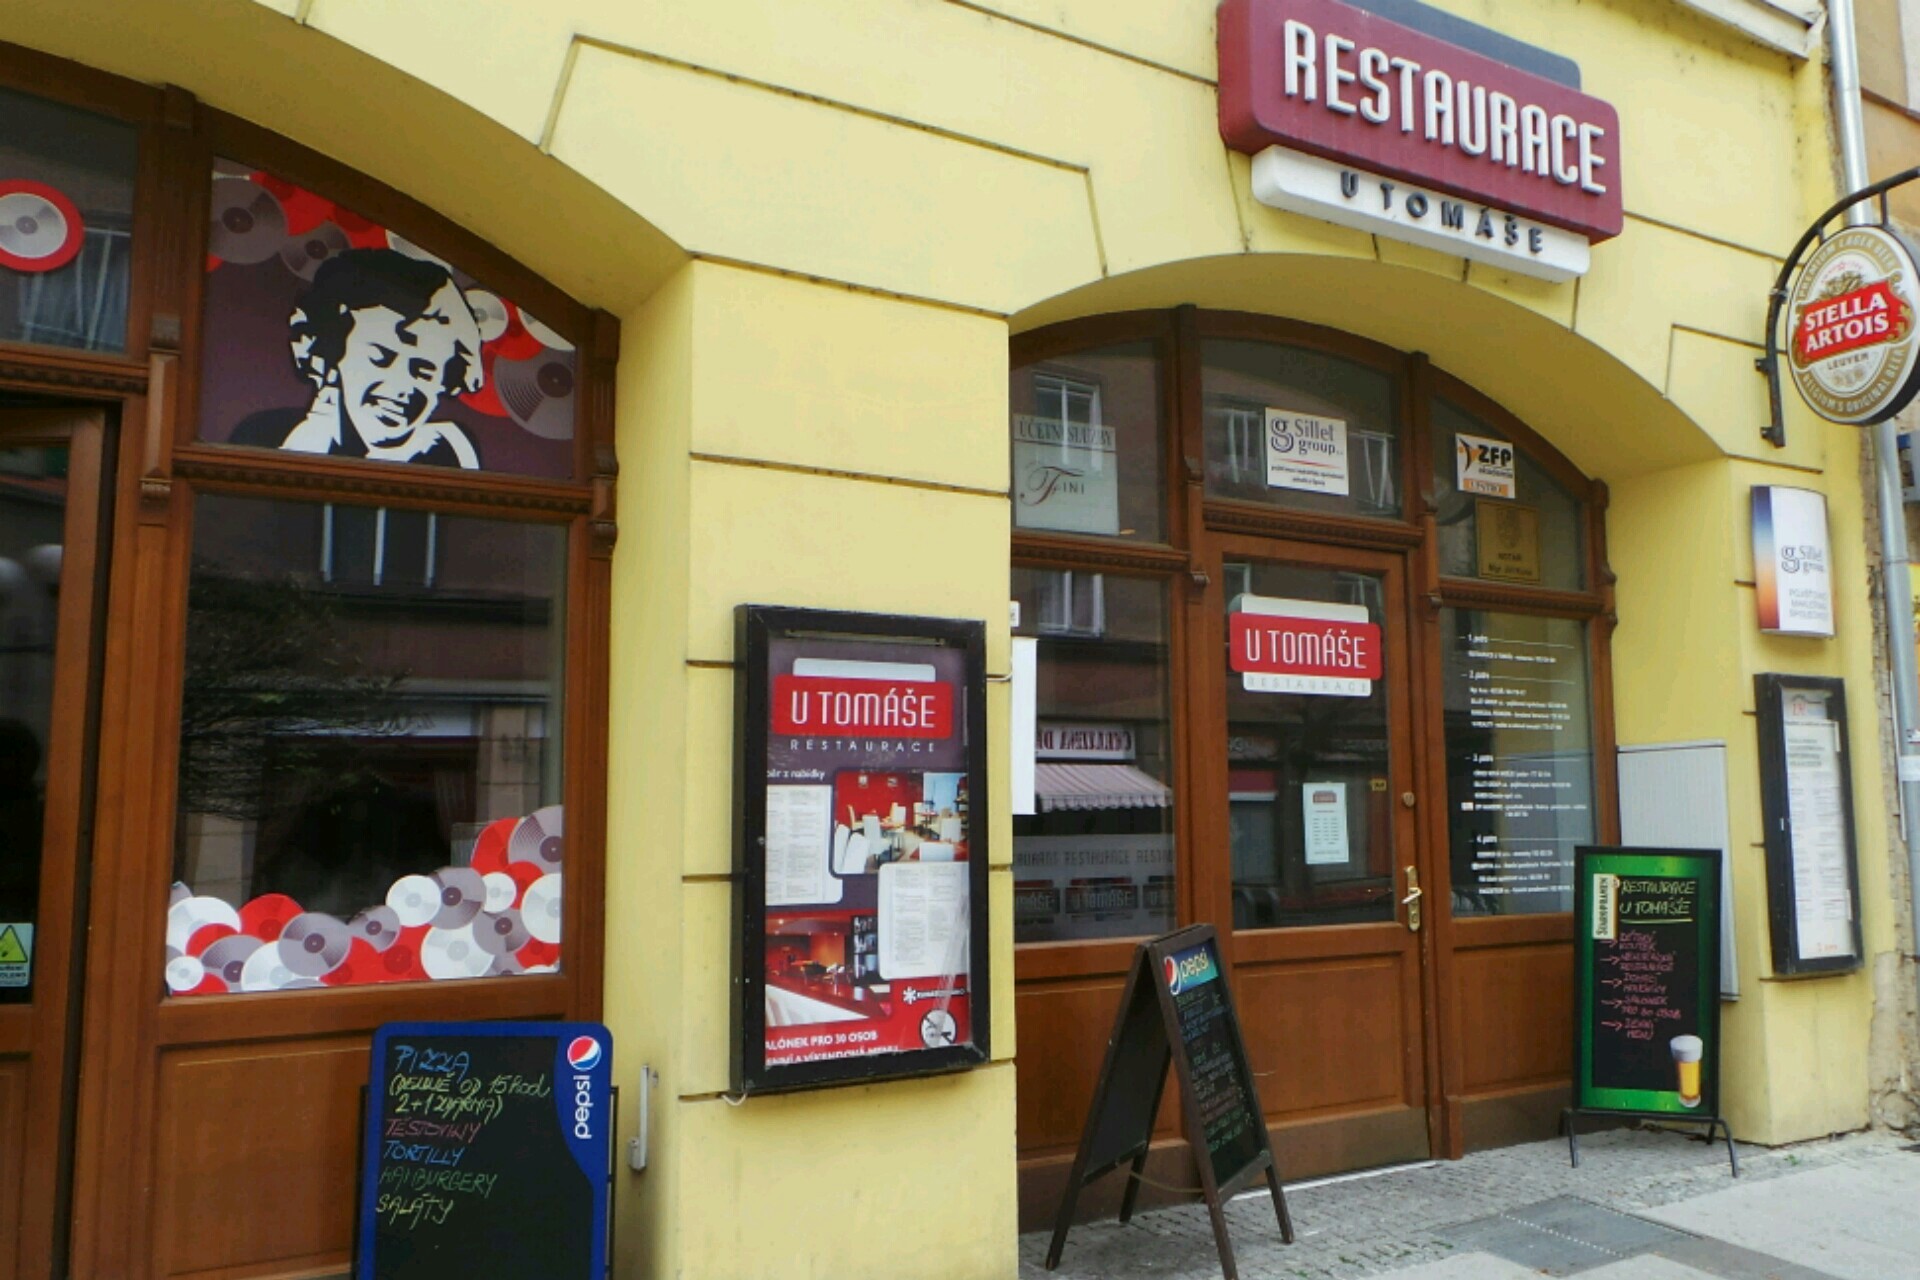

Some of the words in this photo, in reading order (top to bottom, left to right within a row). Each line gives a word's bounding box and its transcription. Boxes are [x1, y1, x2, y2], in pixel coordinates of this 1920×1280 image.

[1284, 19, 1607, 195] RESTAURACE
[1340, 170, 1360, 199] U
[1380, 181, 1544, 254] TOMÁŠE
[1804, 292, 1888, 332] STELLA
[1806, 312, 1890, 353] ARTOIS
[1298, 439, 1336, 457] group
[1477, 443, 1512, 467] ZFP
[1245, 627, 1261, 662] U
[1267, 628, 1368, 669] TOMÁŠE
[791, 690, 808, 724] U
[817, 687, 936, 728] TOMÁŠE
[790, 739, 935, 753] RESTAURACE
[1620, 879, 1697, 896] RESTAURACE
[1180, 949, 1209, 984] pepsi
[573, 1074, 592, 1140] pepsi
